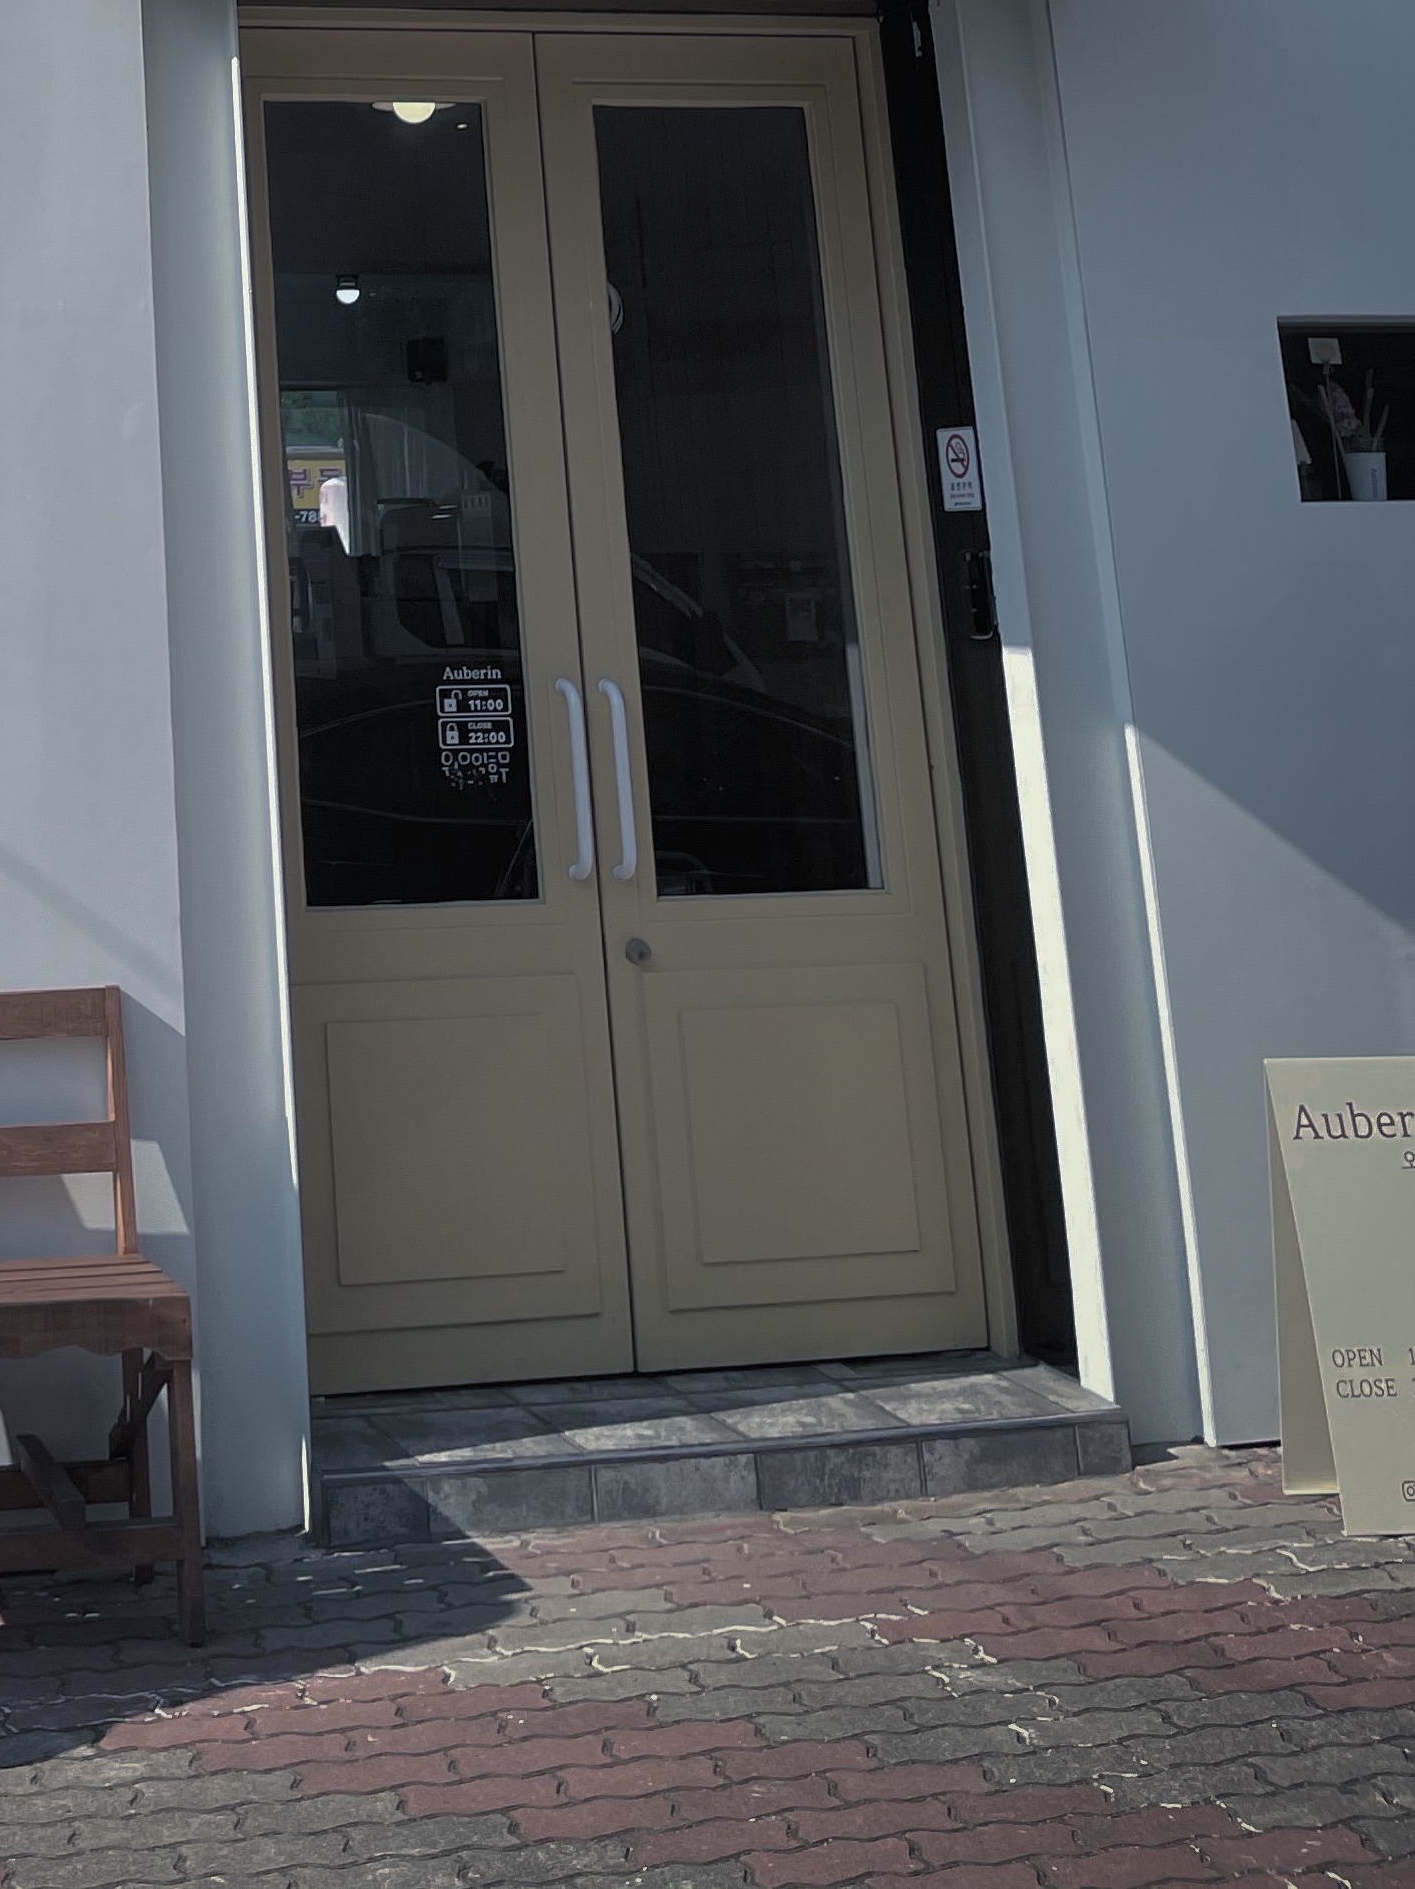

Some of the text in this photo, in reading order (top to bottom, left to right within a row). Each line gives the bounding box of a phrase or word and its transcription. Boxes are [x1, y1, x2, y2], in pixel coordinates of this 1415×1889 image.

[442, 665, 503, 681] Auberin
[467, 689, 489, 698] OPEN
[468, 699, 504, 711] 11:00
[467, 721, 493, 730] CLOSE
[468, 731, 507, 744] 22:00
[1292, 1101, 1415, 1140] Auber
[1331, 1347, 1384, 1368] OPEN
[1336, 1377, 1398, 1399] CLOSE
